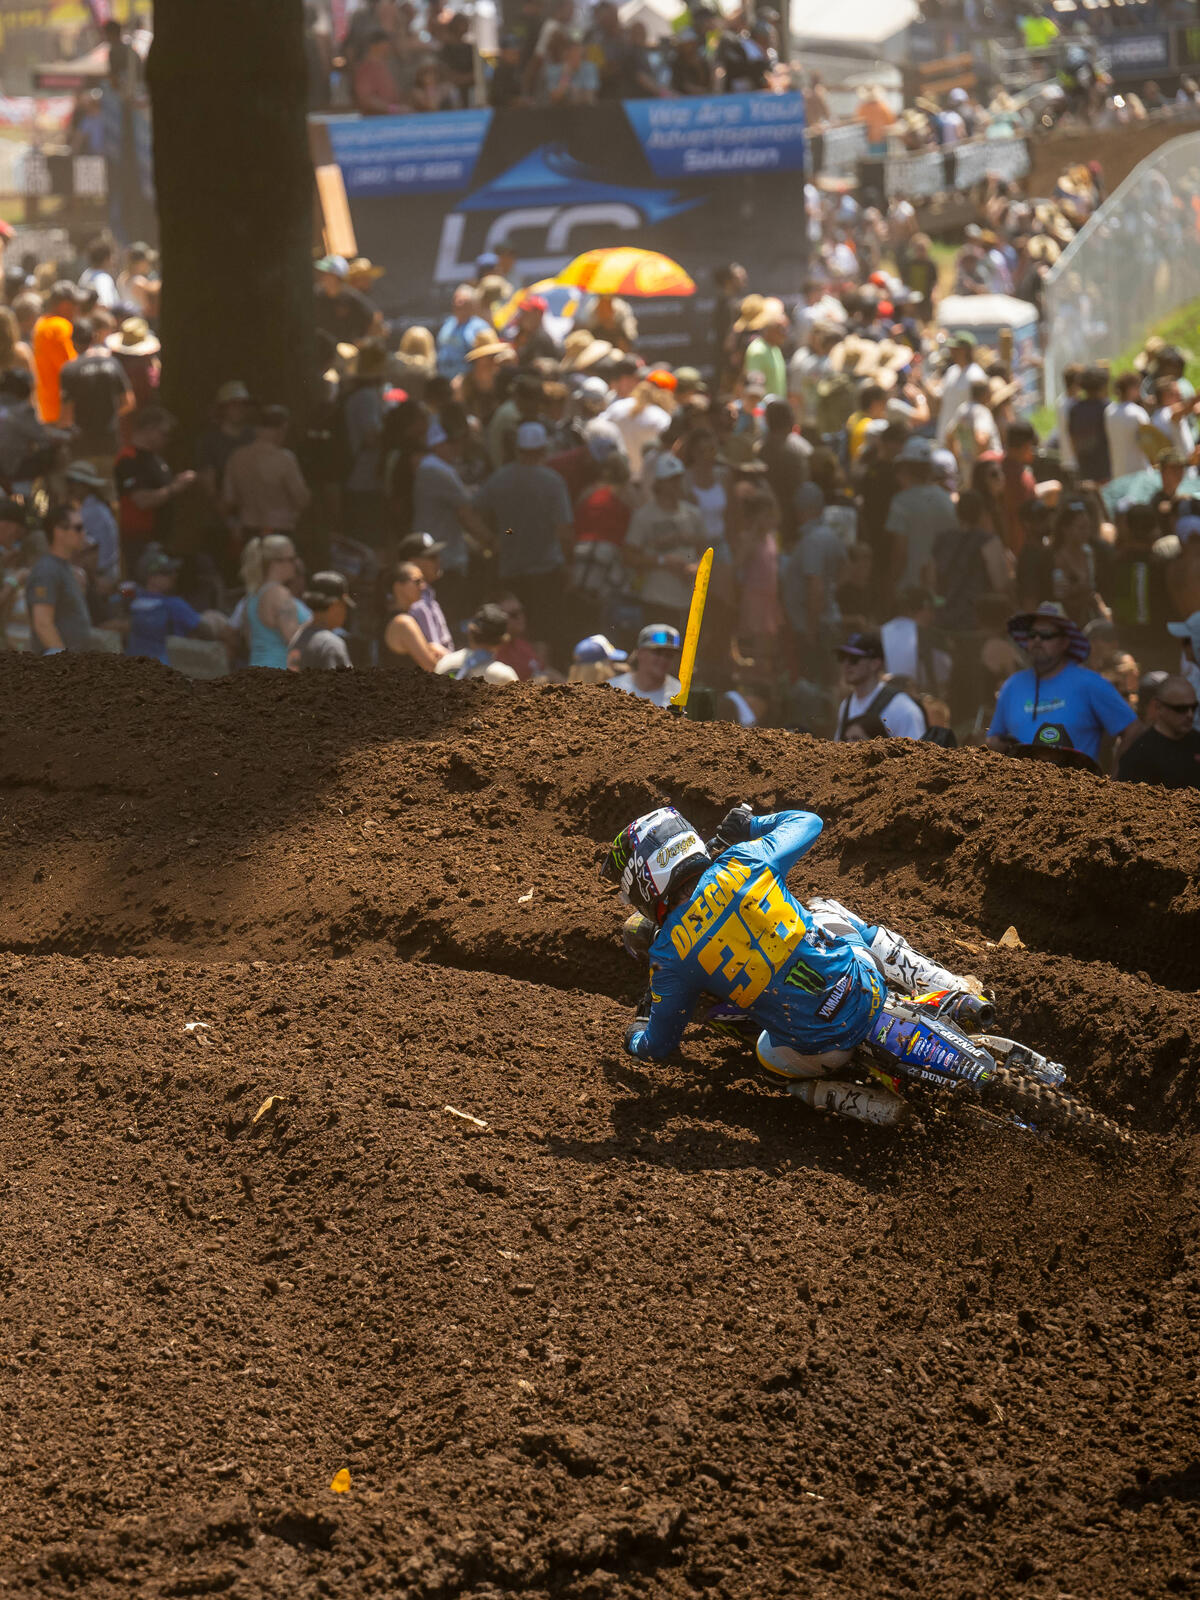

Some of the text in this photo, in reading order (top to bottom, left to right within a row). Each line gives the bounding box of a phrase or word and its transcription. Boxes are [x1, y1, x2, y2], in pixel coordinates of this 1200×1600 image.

[670, 857, 752, 961] DEEGAN
[697, 866, 807, 1009] 38
[940, 1026, 986, 1058] DUNLOP
[920, 1070, 957, 1089] DUNLP
